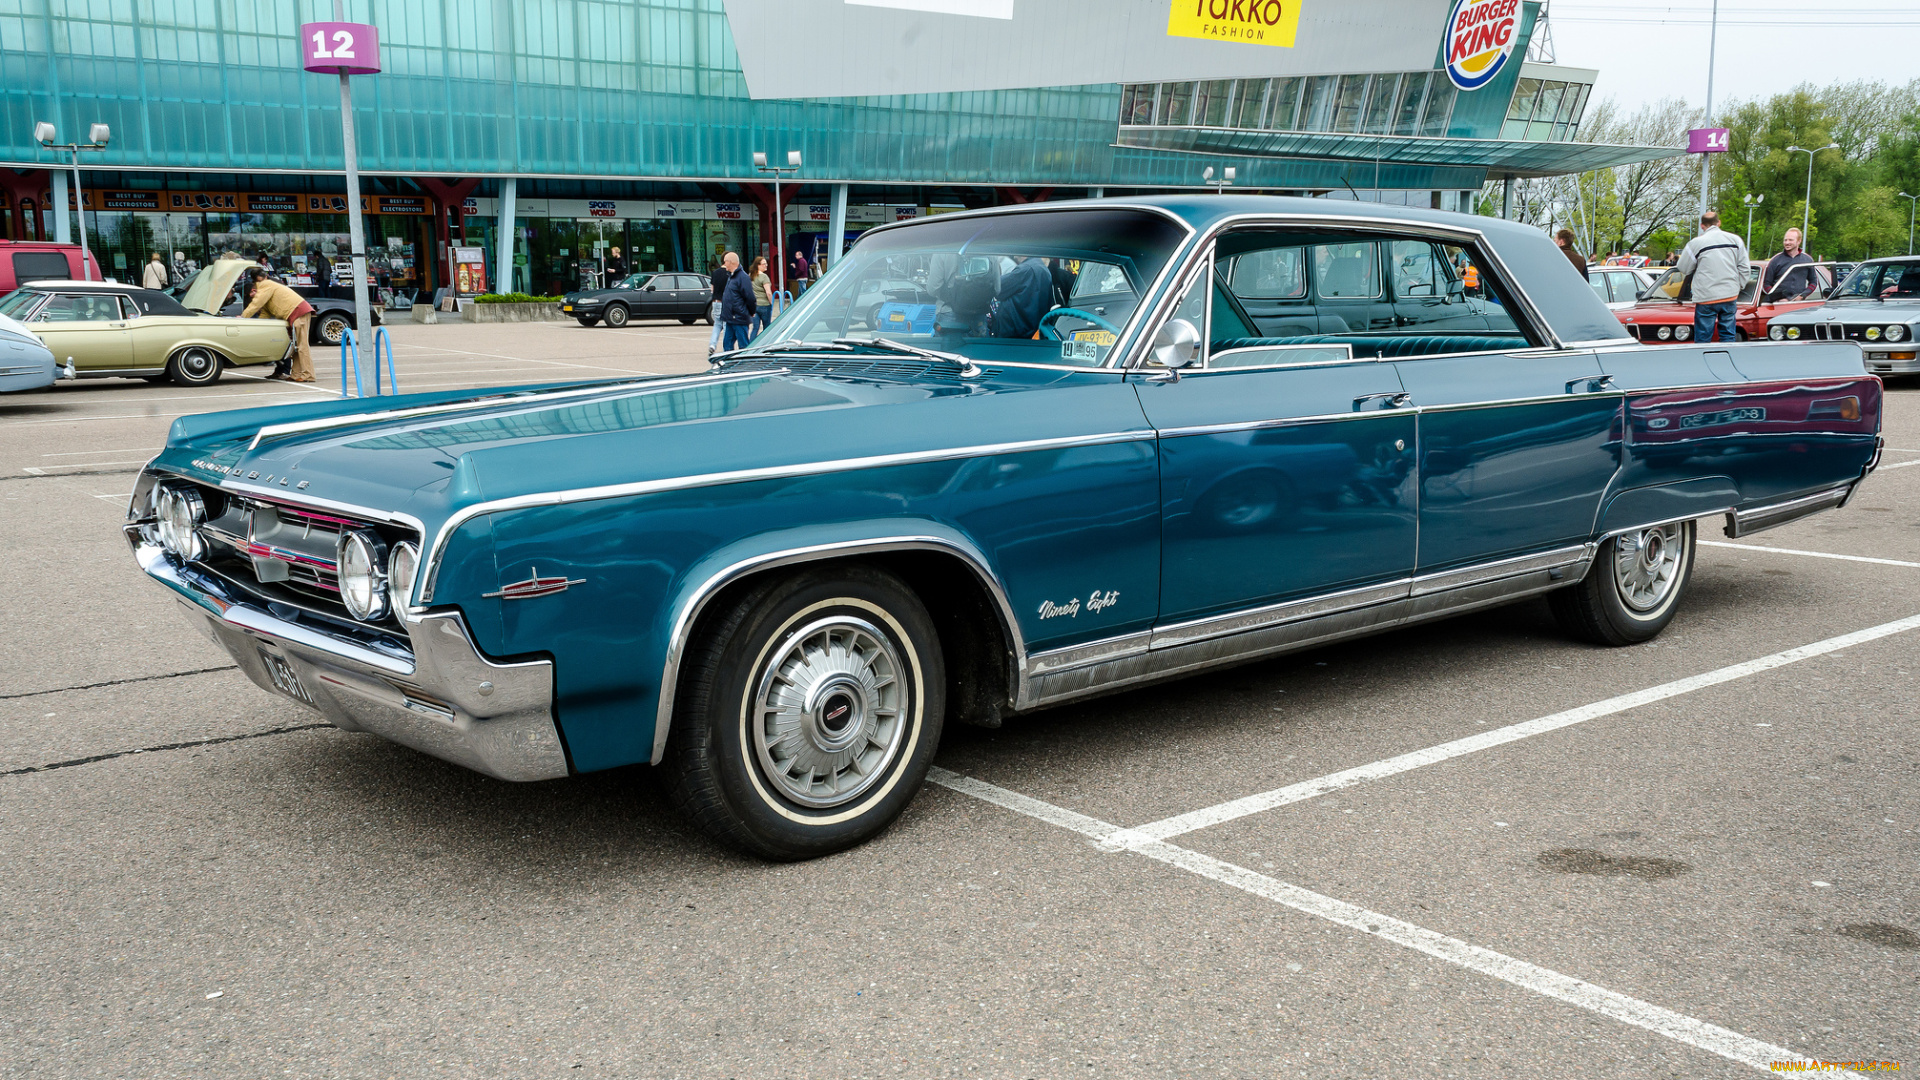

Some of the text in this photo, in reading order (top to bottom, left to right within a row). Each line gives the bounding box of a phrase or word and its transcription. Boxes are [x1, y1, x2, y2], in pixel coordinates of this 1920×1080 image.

[1455, 0, 1518, 33] BURGER
[1203, 24, 1264, 39] FASHION
[312, 30, 355, 59] 12
[1450, 18, 1514, 64] KING
[1707, 132, 1727, 148] 14
[310, 197, 369, 211] BLOK
[588, 201, 616, 209] SPORTS
[716, 203, 741, 211] SPORTS
[809, 205, 831, 213] SPORTS
[589, 209, 616, 217] WORLD
[717, 211, 741, 219] WORLD
[1085, 345, 1096, 358] 95
[1037, 590, 1120, 620] Ninety Eight
